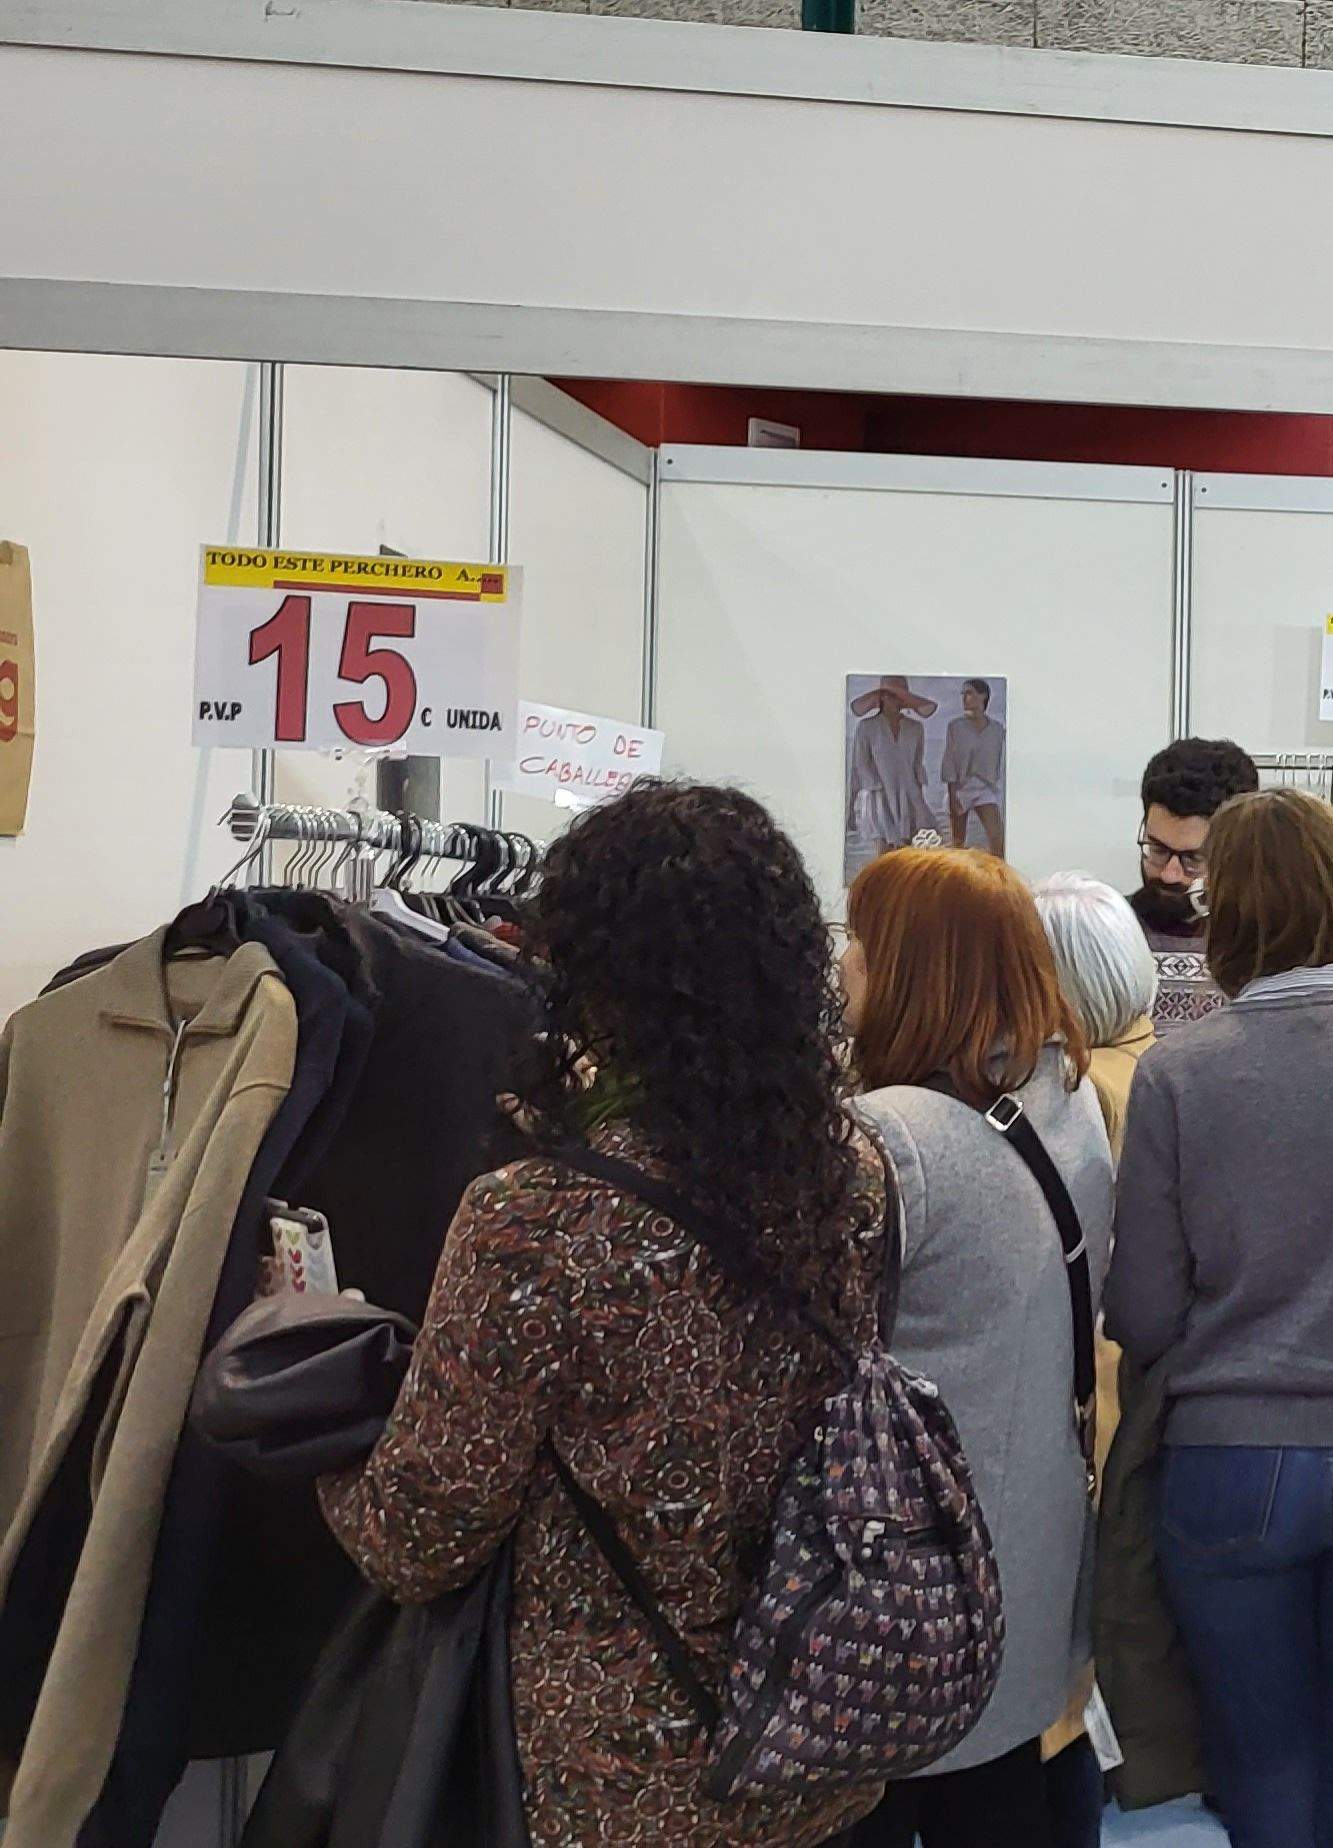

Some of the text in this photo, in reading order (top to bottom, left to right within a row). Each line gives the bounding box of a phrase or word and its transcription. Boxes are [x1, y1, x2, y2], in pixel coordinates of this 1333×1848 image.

[206, 551, 267, 568] TODO
[274, 556, 325, 572] ESTE
[330, 560, 442, 580] PERCHERO
[200, 701, 242, 721] P.V.P
[248, 595, 417, 747] 15
[446, 708, 502, 731] UNIDA
[524, 716, 644, 758] PUNTO DE
